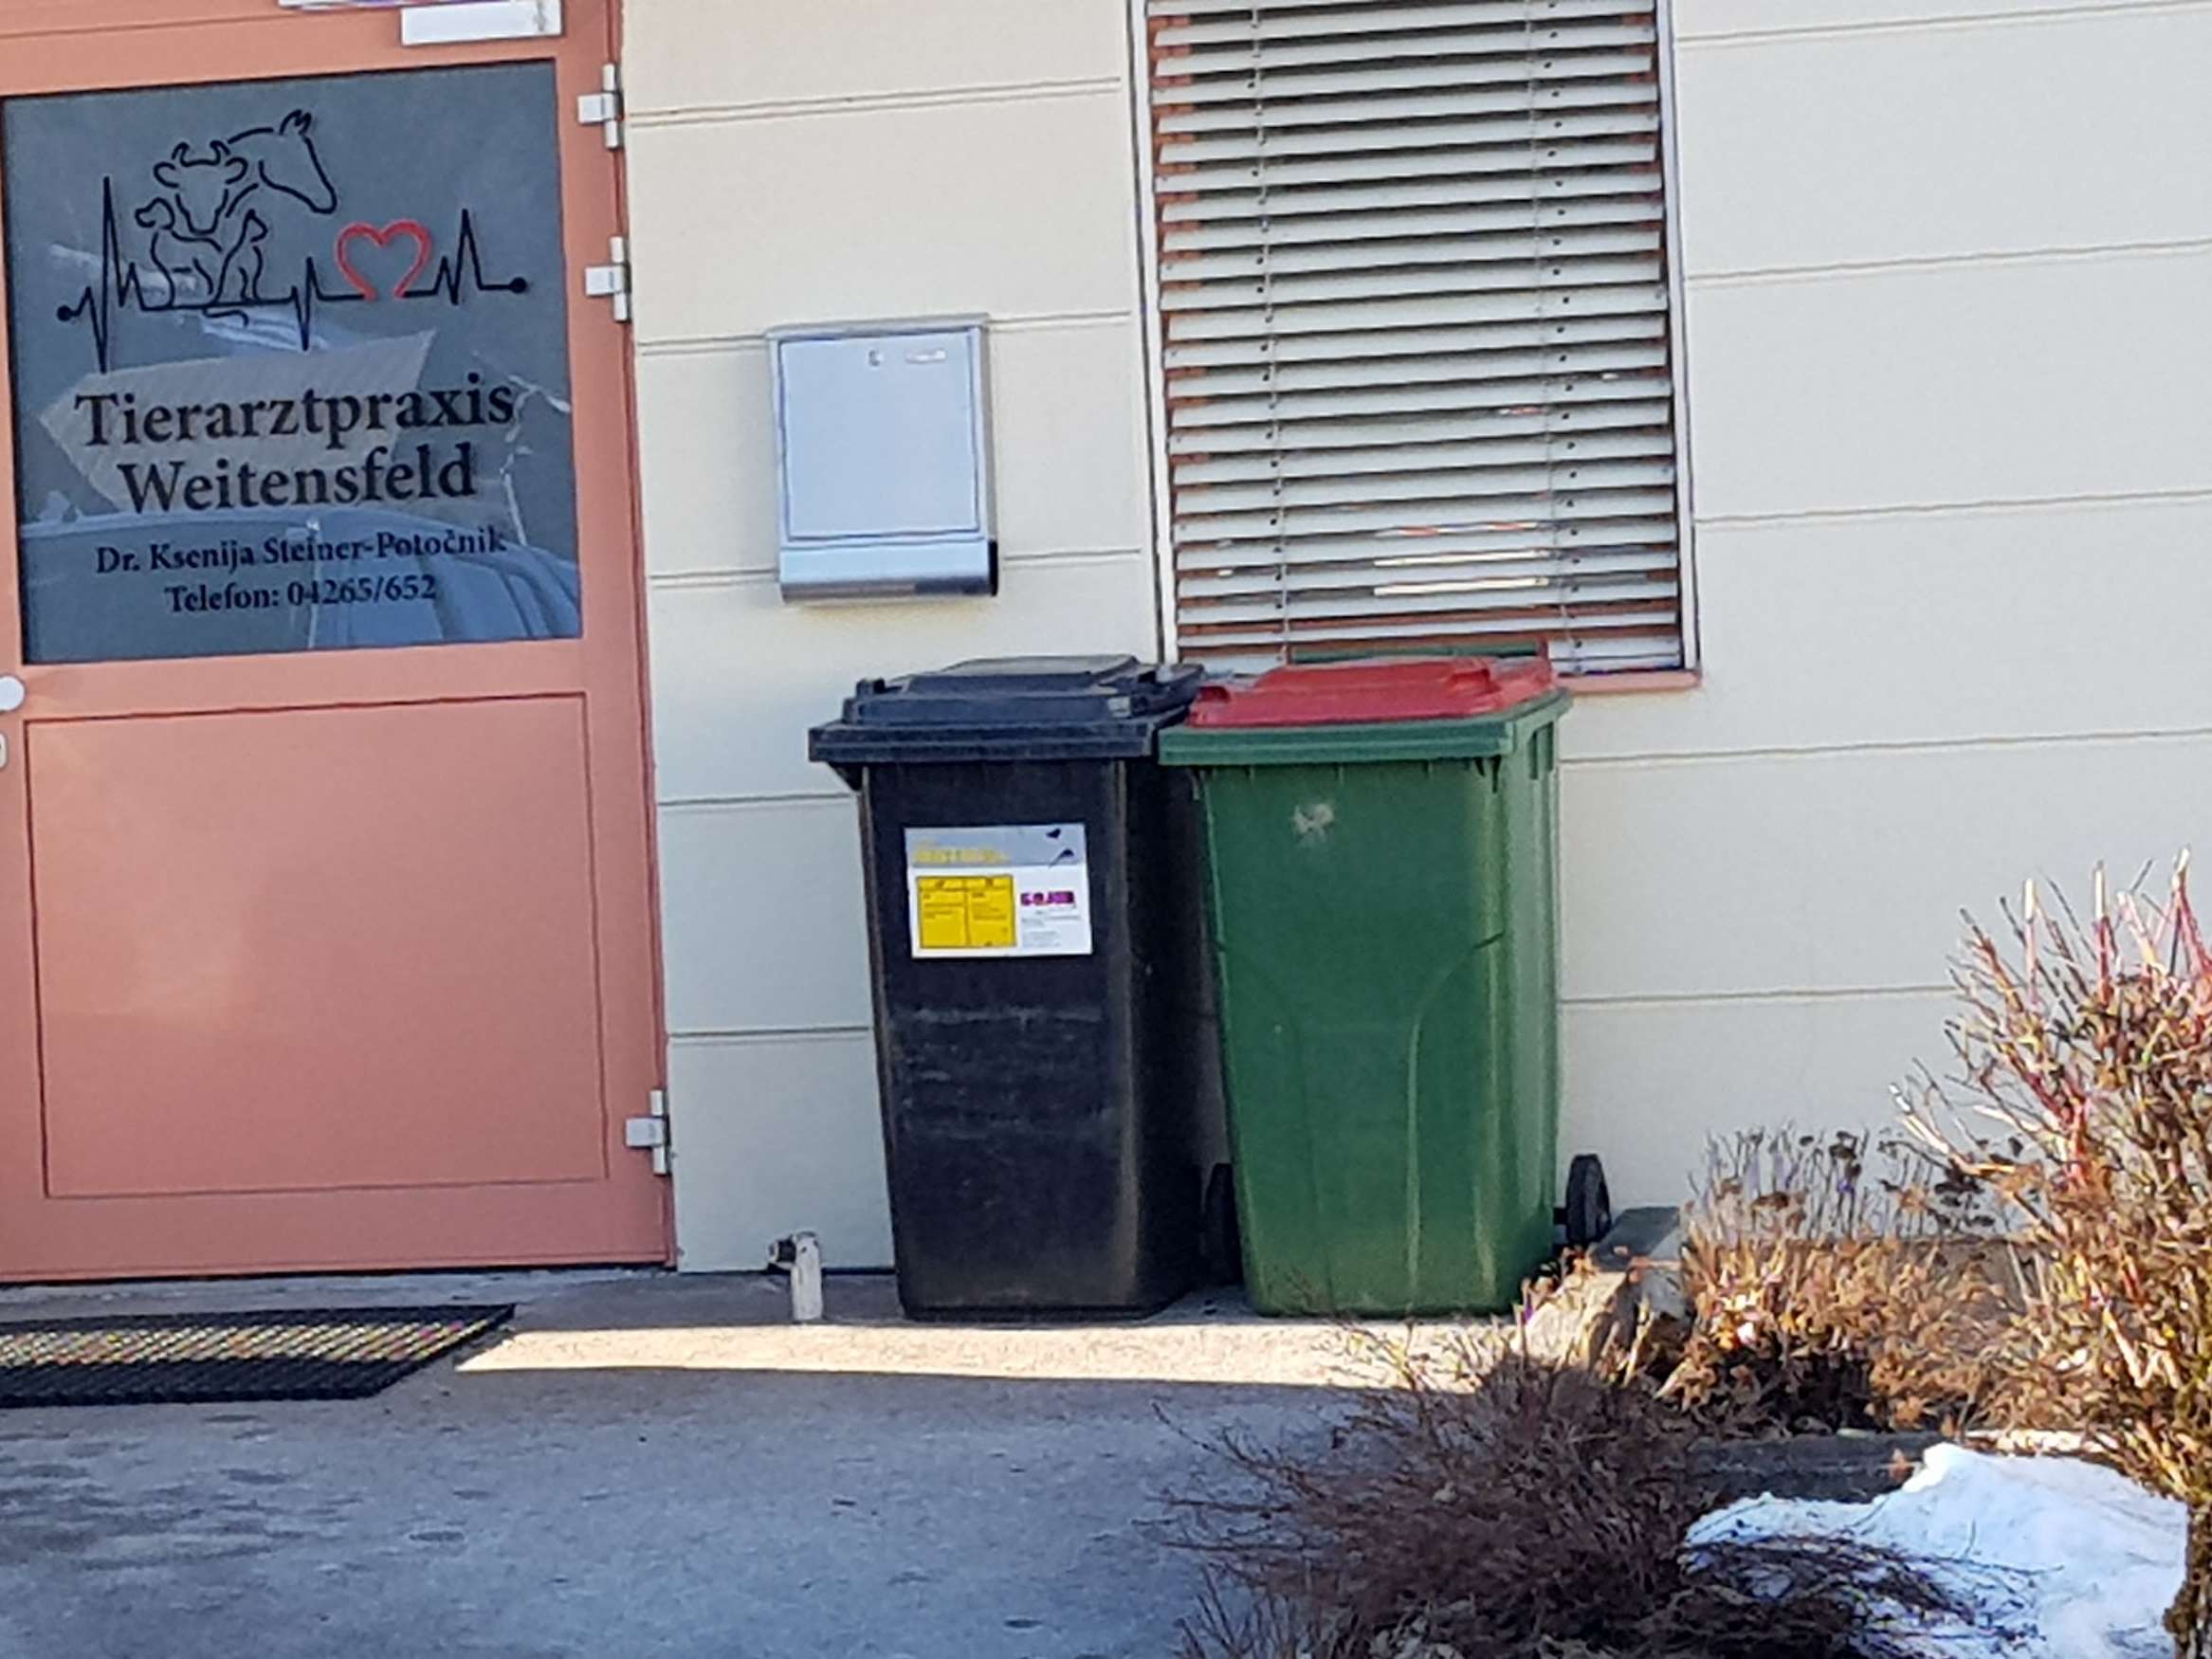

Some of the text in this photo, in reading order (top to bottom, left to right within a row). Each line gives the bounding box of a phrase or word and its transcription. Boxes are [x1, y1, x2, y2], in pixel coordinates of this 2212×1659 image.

[74, 372, 514, 450] Tierarztpraxis
[117, 441, 477, 514] Weitensfeld
[97, 524, 507, 574] Dr. Ksenija Steiner-Potočnik
[164, 574, 437, 612] Telefon: 04265/652
